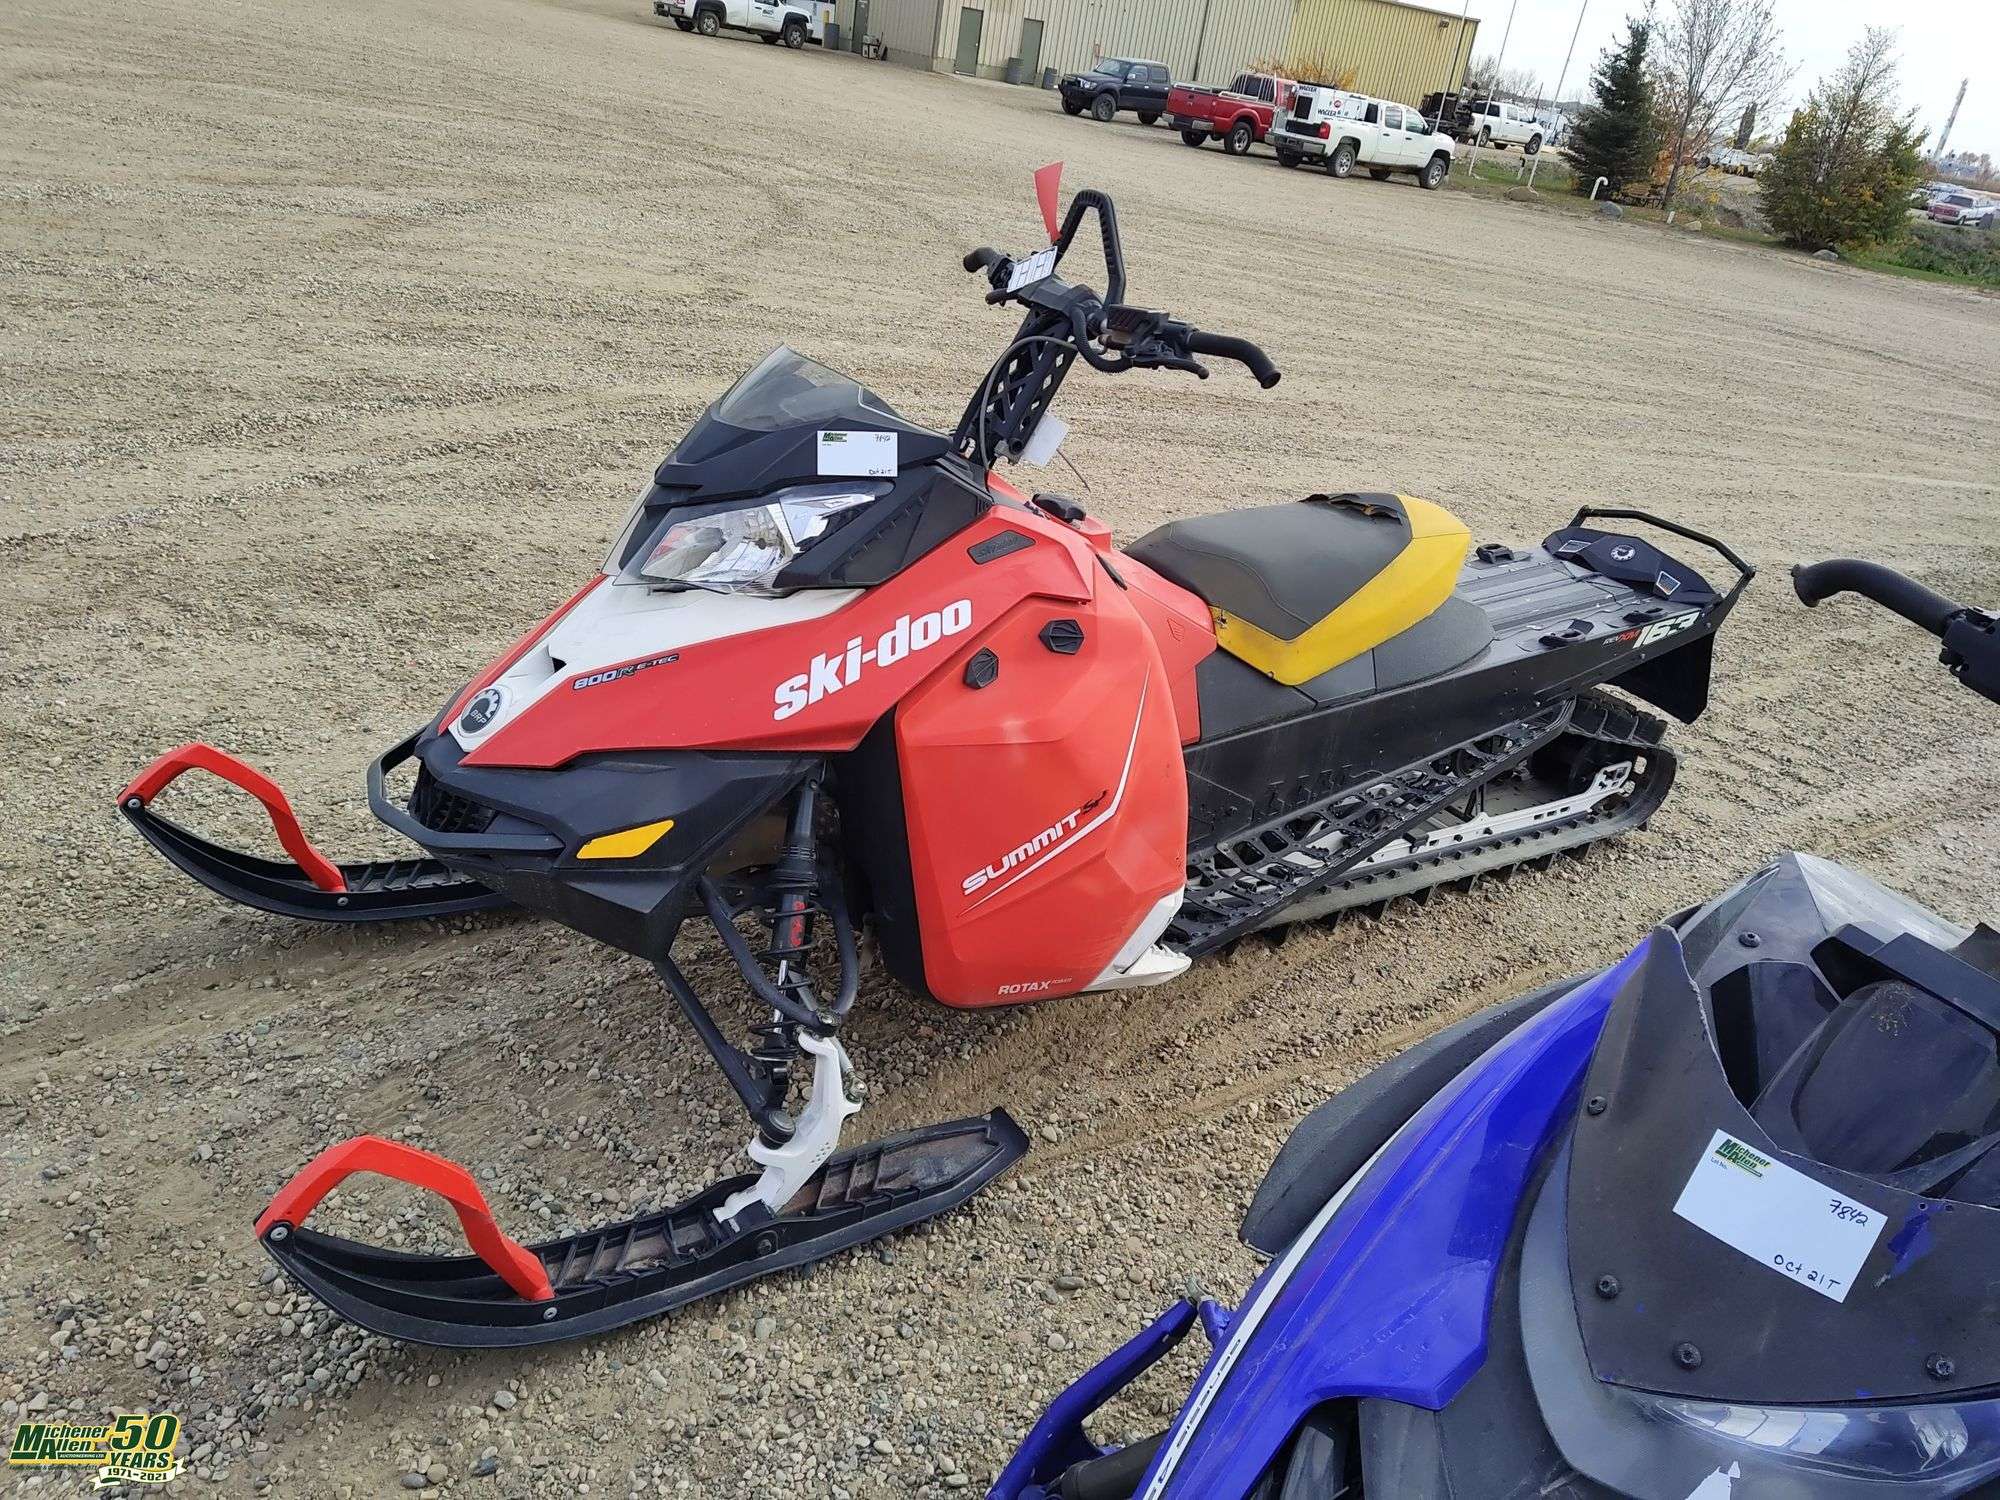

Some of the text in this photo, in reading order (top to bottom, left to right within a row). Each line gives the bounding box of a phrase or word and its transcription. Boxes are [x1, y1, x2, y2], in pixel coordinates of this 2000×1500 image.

[1632, 610, 1700, 649] 163
[771, 598, 974, 721] ski-doo
[469, 708, 488, 724] BRP
[961, 808, 1082, 896] SUMMIT
[998, 980, 1051, 995] ROTAX
[1829, 1199, 1869, 1227] 7842
[1773, 1254, 1804, 1275] Oct
